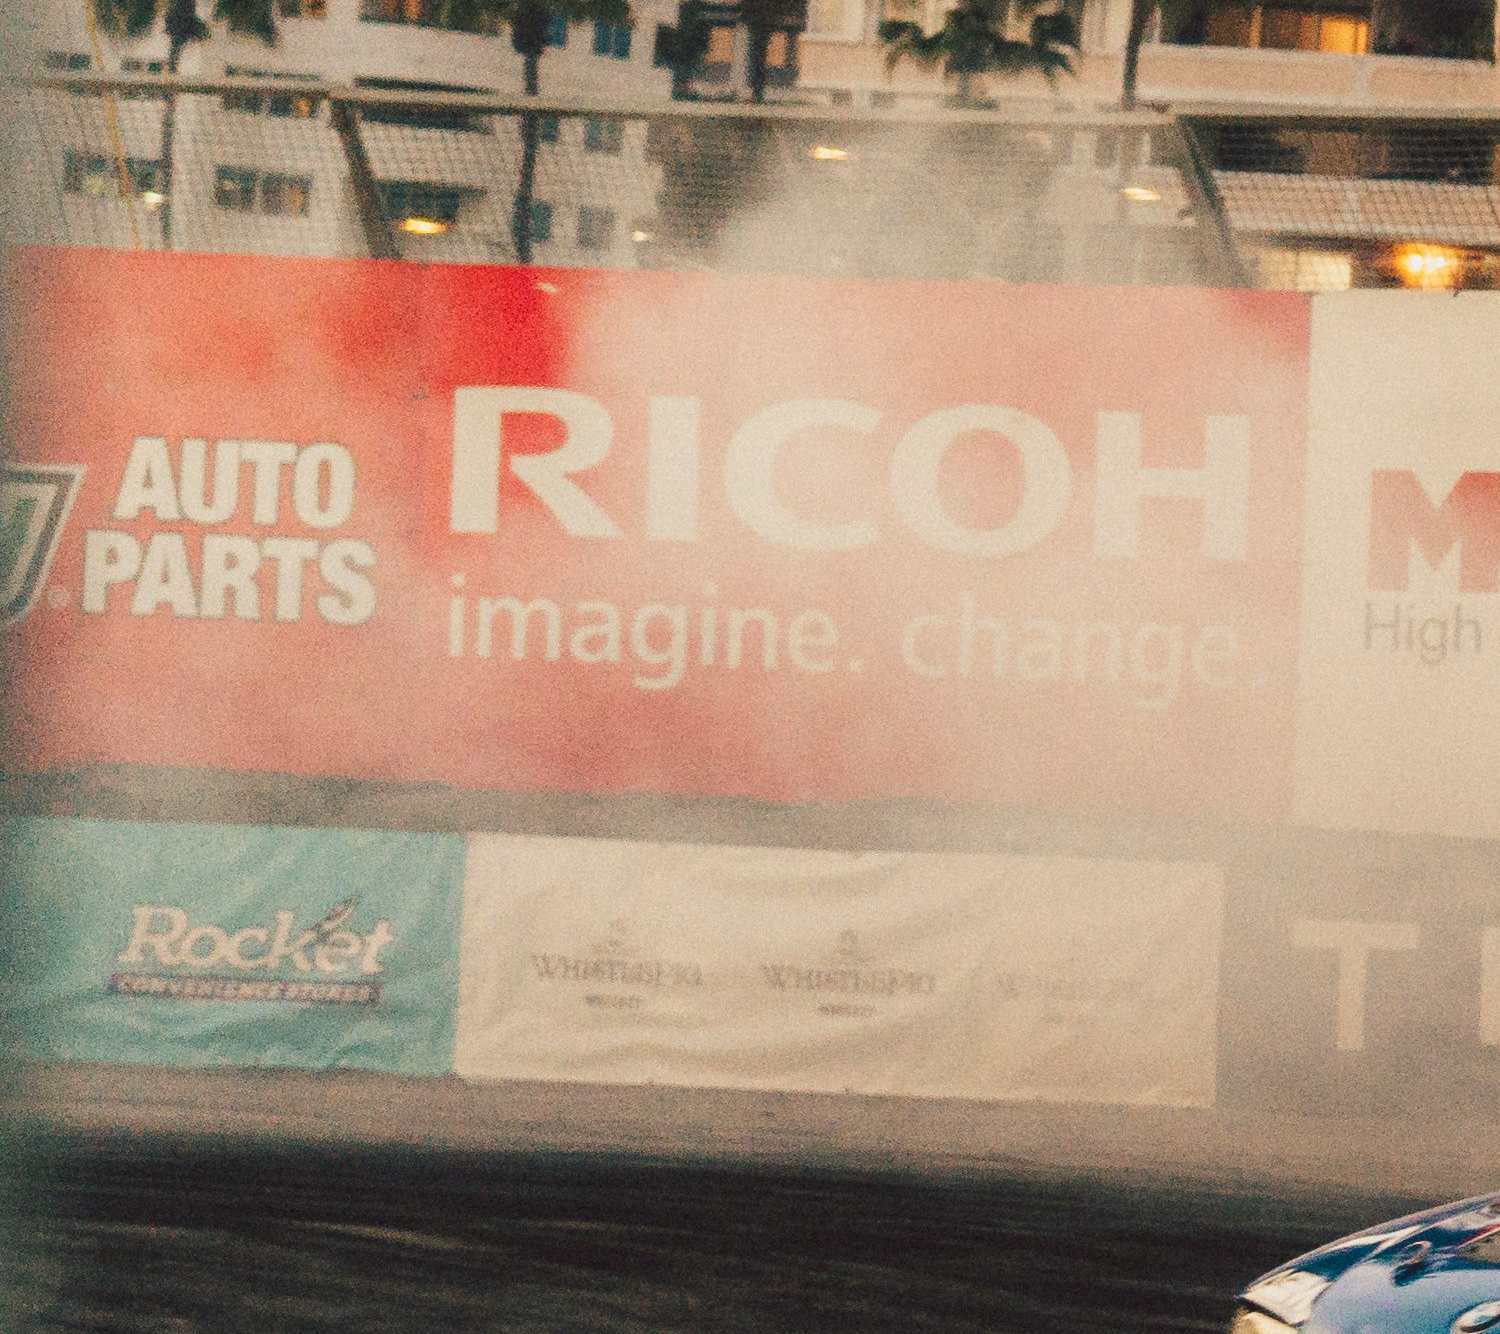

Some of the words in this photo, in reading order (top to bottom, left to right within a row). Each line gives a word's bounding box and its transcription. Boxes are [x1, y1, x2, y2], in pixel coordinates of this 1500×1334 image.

[112, 436, 356, 528] AUTO
[449, 384, 1251, 561] RICOH
[80, 529, 378, 625] PARTS
[448, 573, 862, 692] imagine.
[902, 589, 1266, 711] change.
[1363, 602, 1483, 665] High
[117, 901, 393, 975] Rocket
